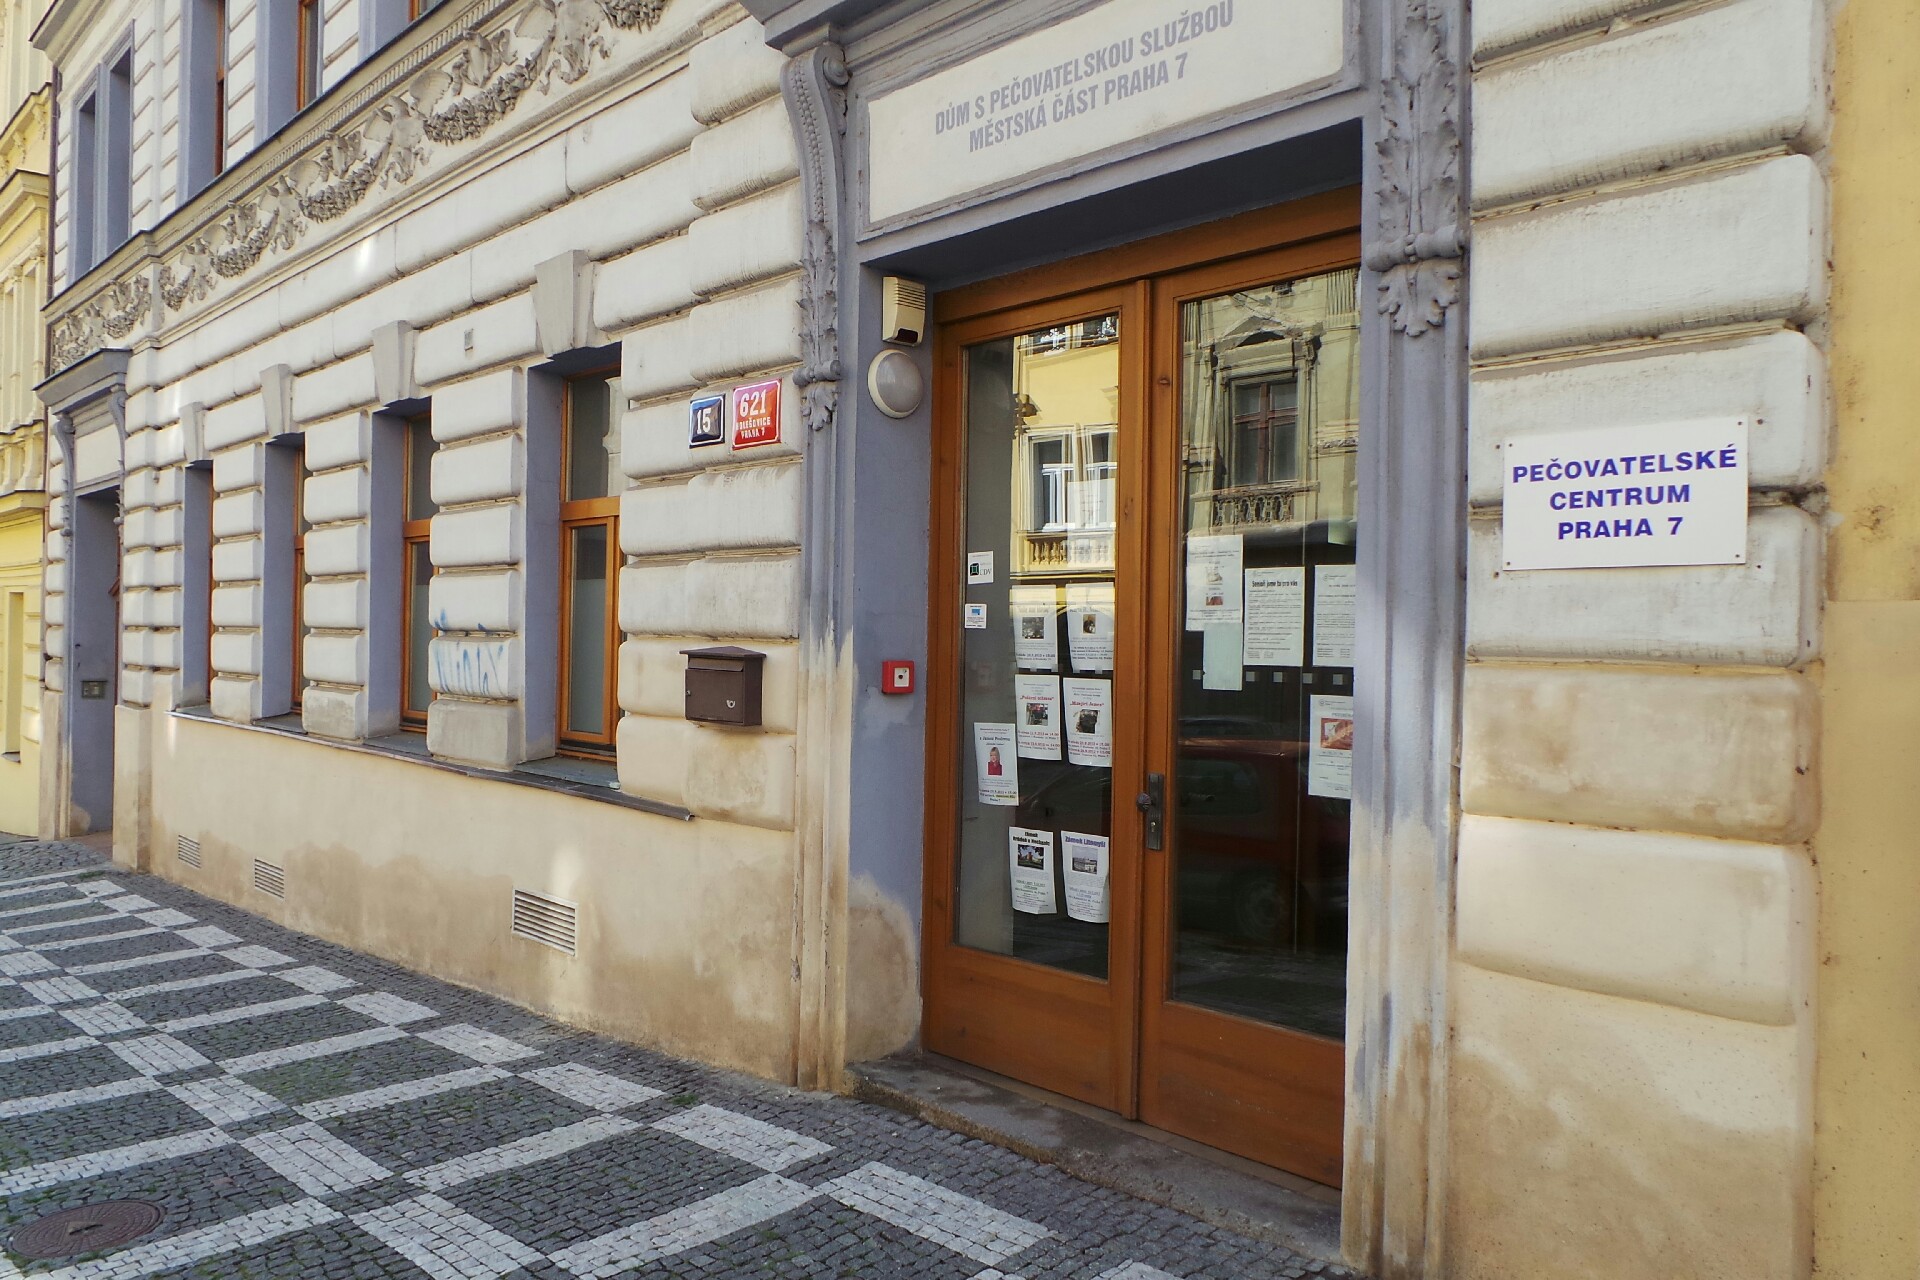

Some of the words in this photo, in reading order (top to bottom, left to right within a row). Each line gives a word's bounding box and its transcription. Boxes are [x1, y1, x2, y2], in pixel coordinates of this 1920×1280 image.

[935, 102, 970, 135] DŮM
[974, 96, 985, 119] S
[990, 37, 1134, 113] PEČOVATELSKOU
[1140, 0, 1234, 56] SLUŽBOU
[969, 100, 1047, 152] MĚSTSKÁ
[1052, 84, 1099, 123] ČÁST
[1104, 60, 1169, 105] PRAHA
[1175, 52, 1188, 80] 7
[740, 389, 766, 417] 621
[697, 407, 711, 434] 15
[741, 429, 760, 439] PRAHA
[761, 427, 766, 436] 7
[1513, 443, 1737, 483] PEČOVATELSKÉ
[1550, 484, 1690, 511] CENTRUM
[1558, 518, 1653, 540] PRAHA
[1667, 516, 1683, 536] 7
